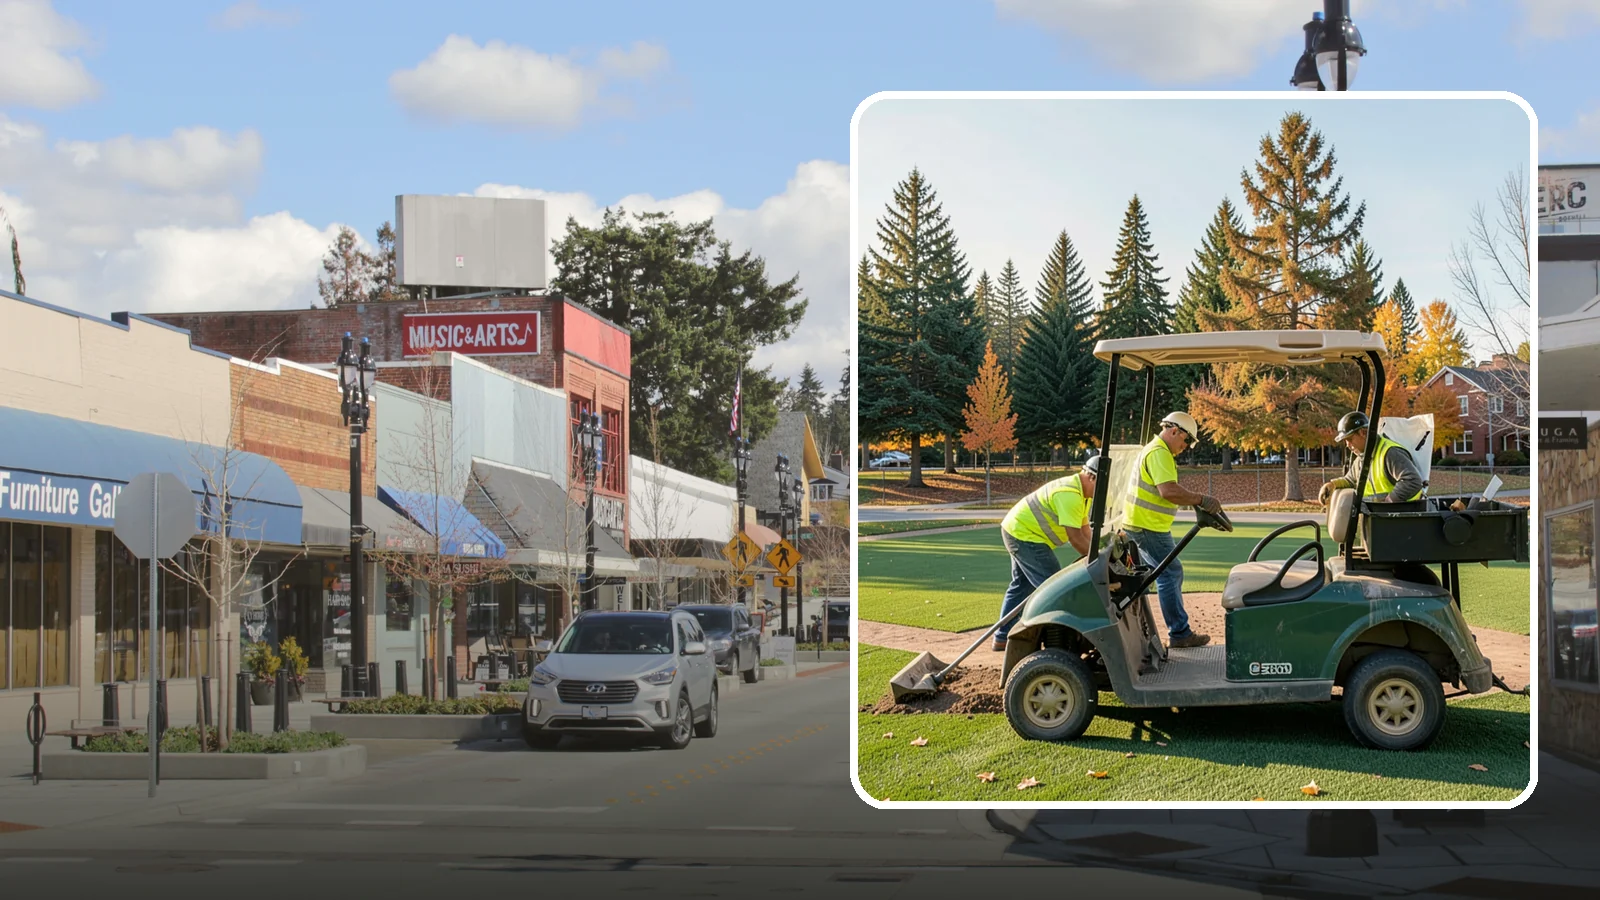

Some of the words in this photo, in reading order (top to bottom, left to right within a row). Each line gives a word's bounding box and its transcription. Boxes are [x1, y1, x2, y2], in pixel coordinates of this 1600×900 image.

[408, 322, 519, 349] MUSIC&ARTS
[1540, 427, 1578, 436] UGA
[0, 471, 79, 515] Furniture
[89, 482, 122, 519] Gal
[453, 563, 479, 574] SUSHI
